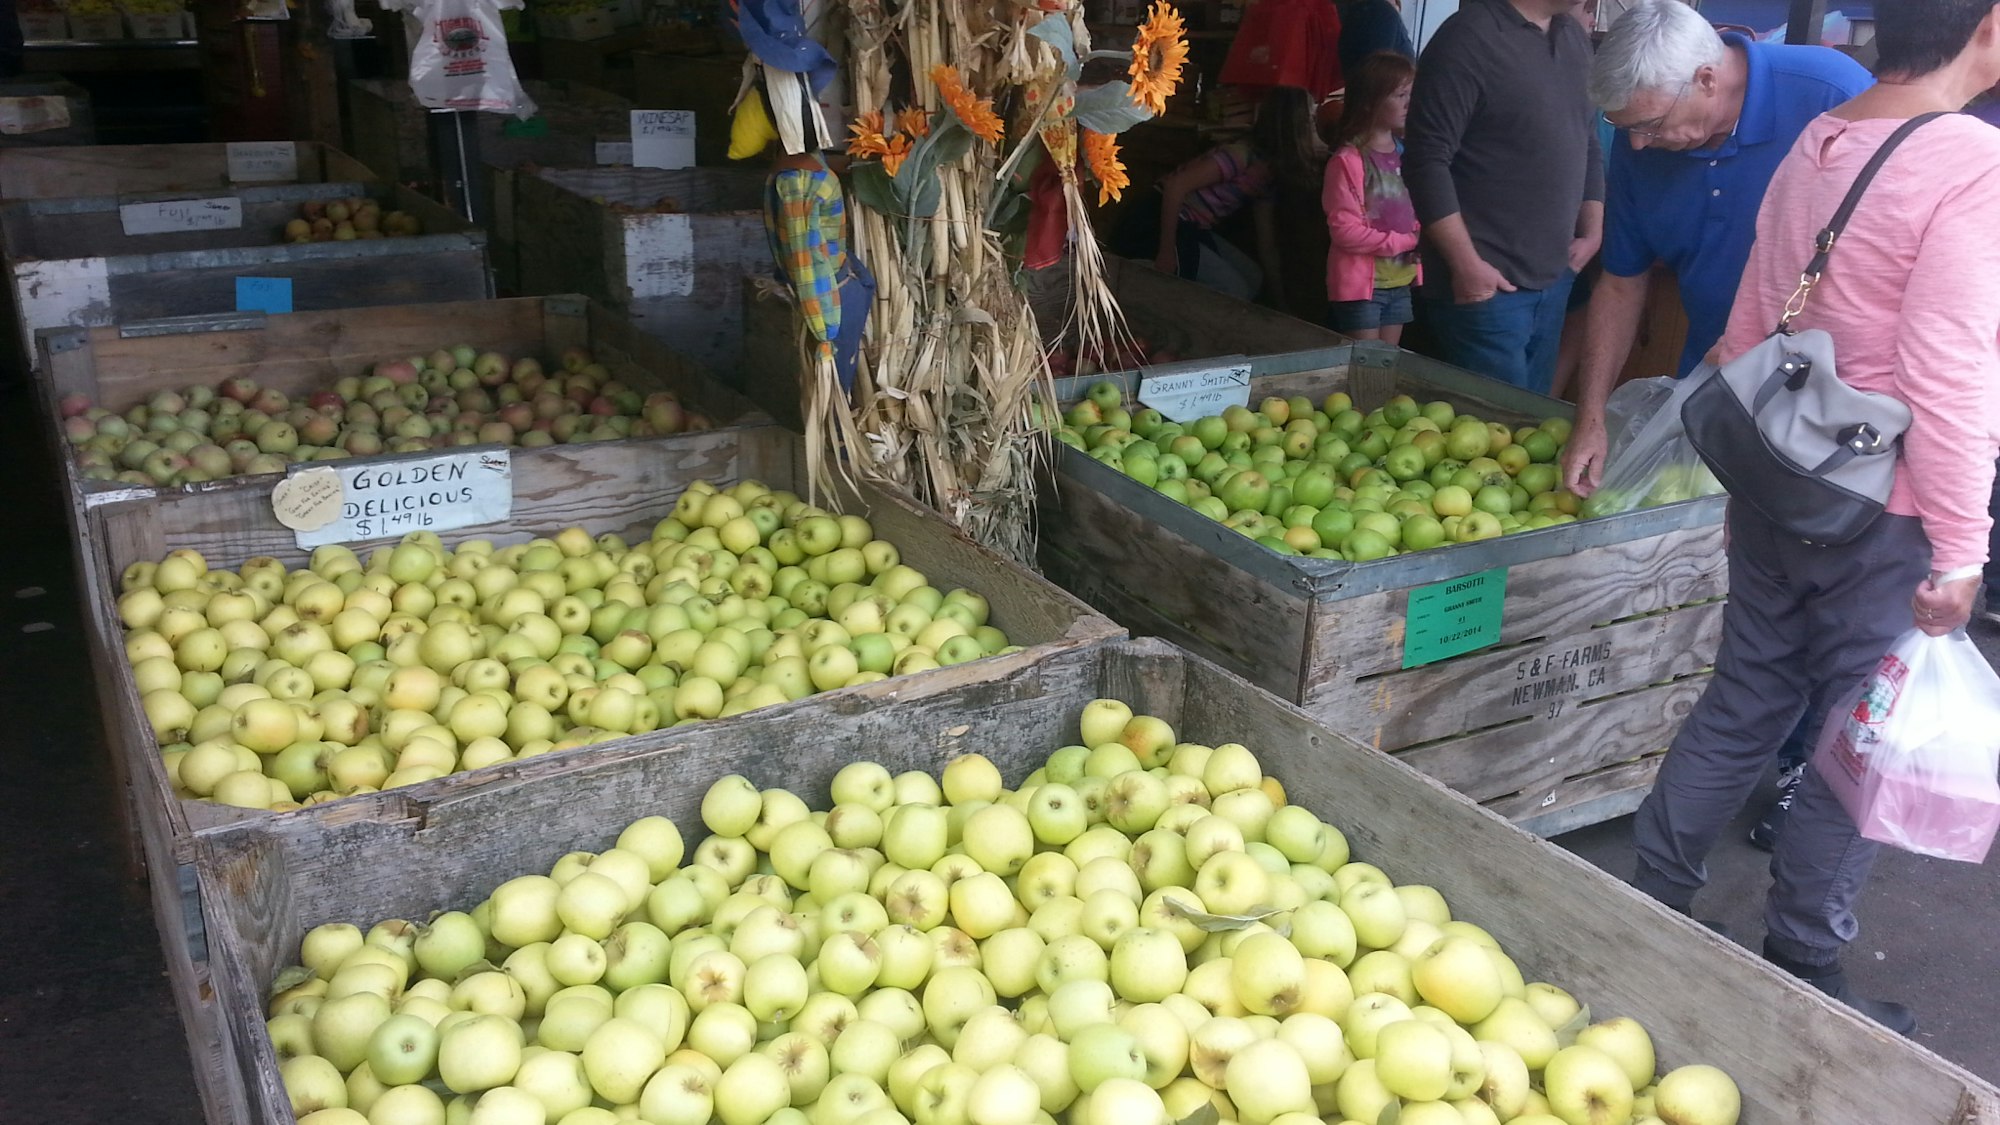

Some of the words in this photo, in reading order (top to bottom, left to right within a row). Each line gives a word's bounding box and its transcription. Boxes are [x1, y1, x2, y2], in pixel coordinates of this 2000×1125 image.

[353, 460, 470, 491] GOLDEN
[343, 487, 474, 519] DELICIOUS
[417, 512, 434, 527] lb
[1445, 577, 1485, 595] BARSOTTI
[1439, 625, 1482, 645] 10/22/2014
[1516, 662, 1526, 680] S
[1530, 658, 1543, 677] &
[1545, 654, 1556, 674] F
[1562, 641, 1612, 670] FARMS
[1587, 667, 1606, 687] CA
